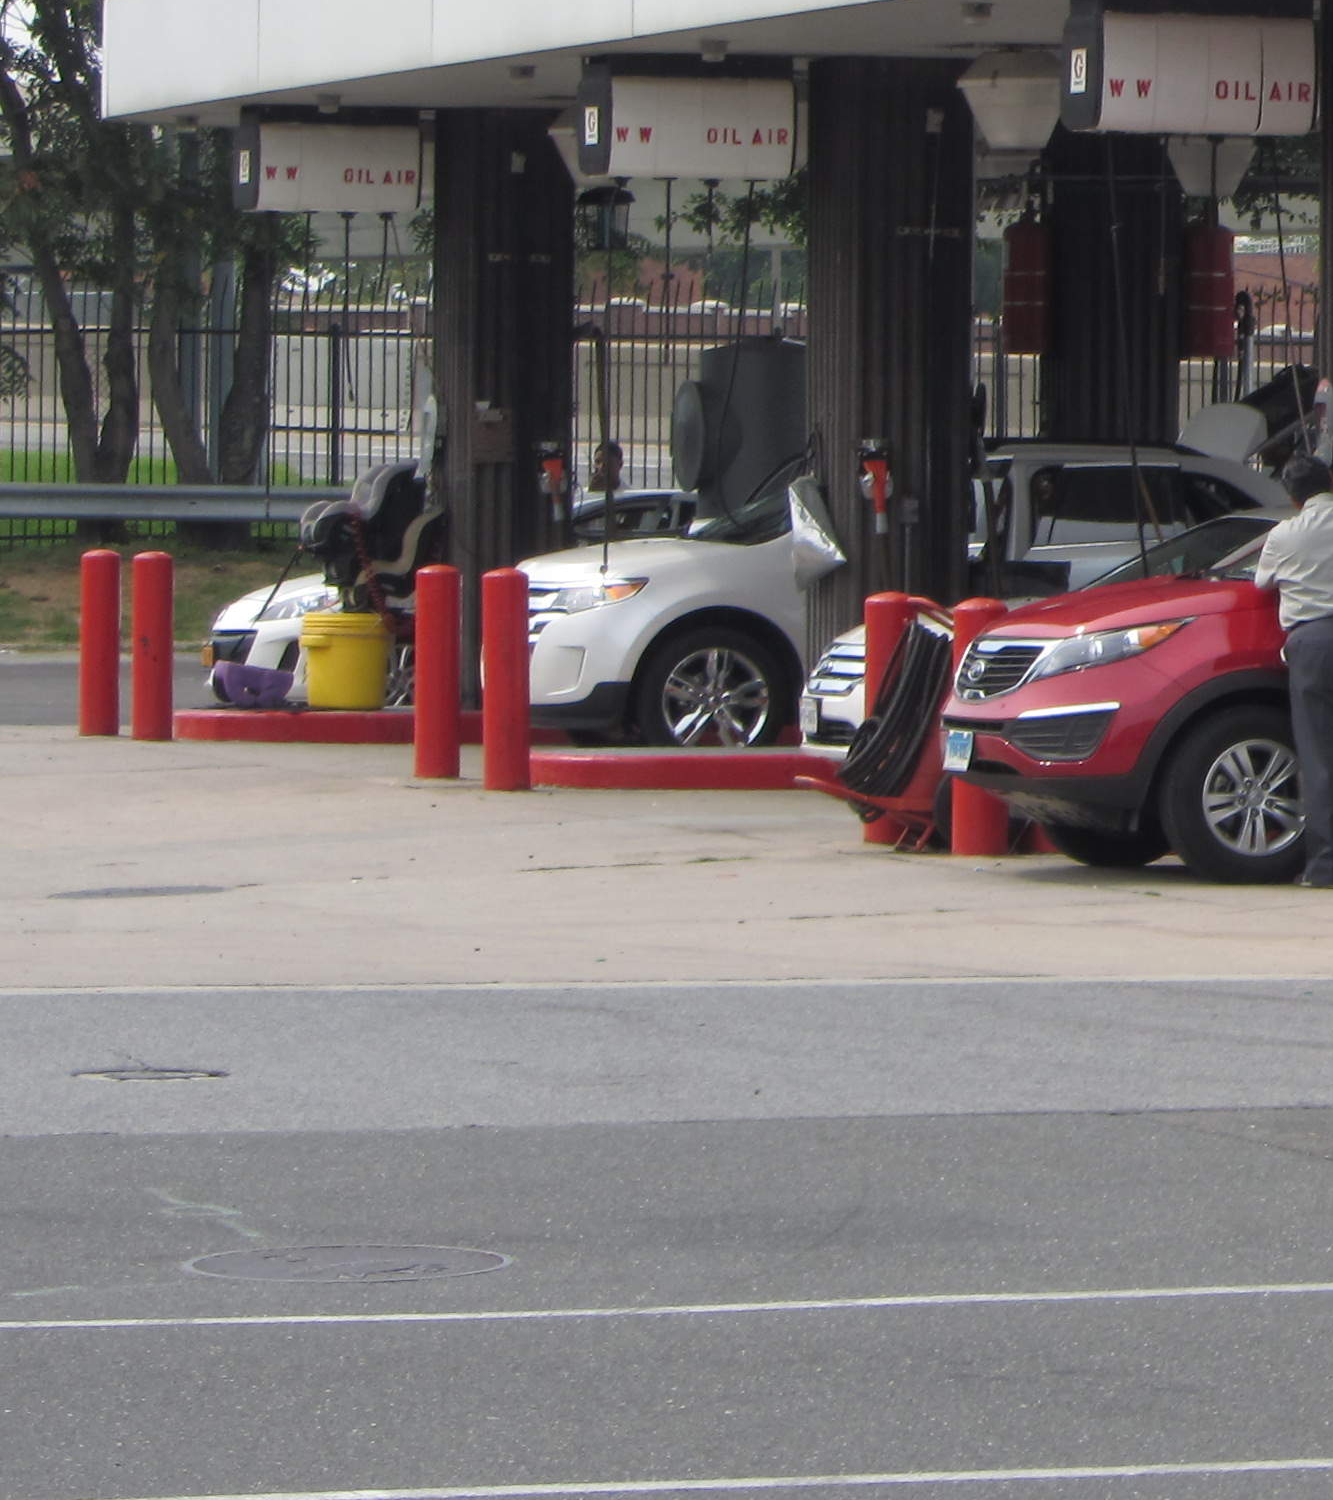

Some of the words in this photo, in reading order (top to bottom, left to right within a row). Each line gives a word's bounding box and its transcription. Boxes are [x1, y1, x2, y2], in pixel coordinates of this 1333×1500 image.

[1215, 80, 1256, 101] OIL
[1269, 81, 1311, 103] AIR
[707, 128, 742, 145] OIL
[752, 128, 788, 145] AIR
[344, 168, 374, 184] OIL
[383, 170, 416, 185] AIR
